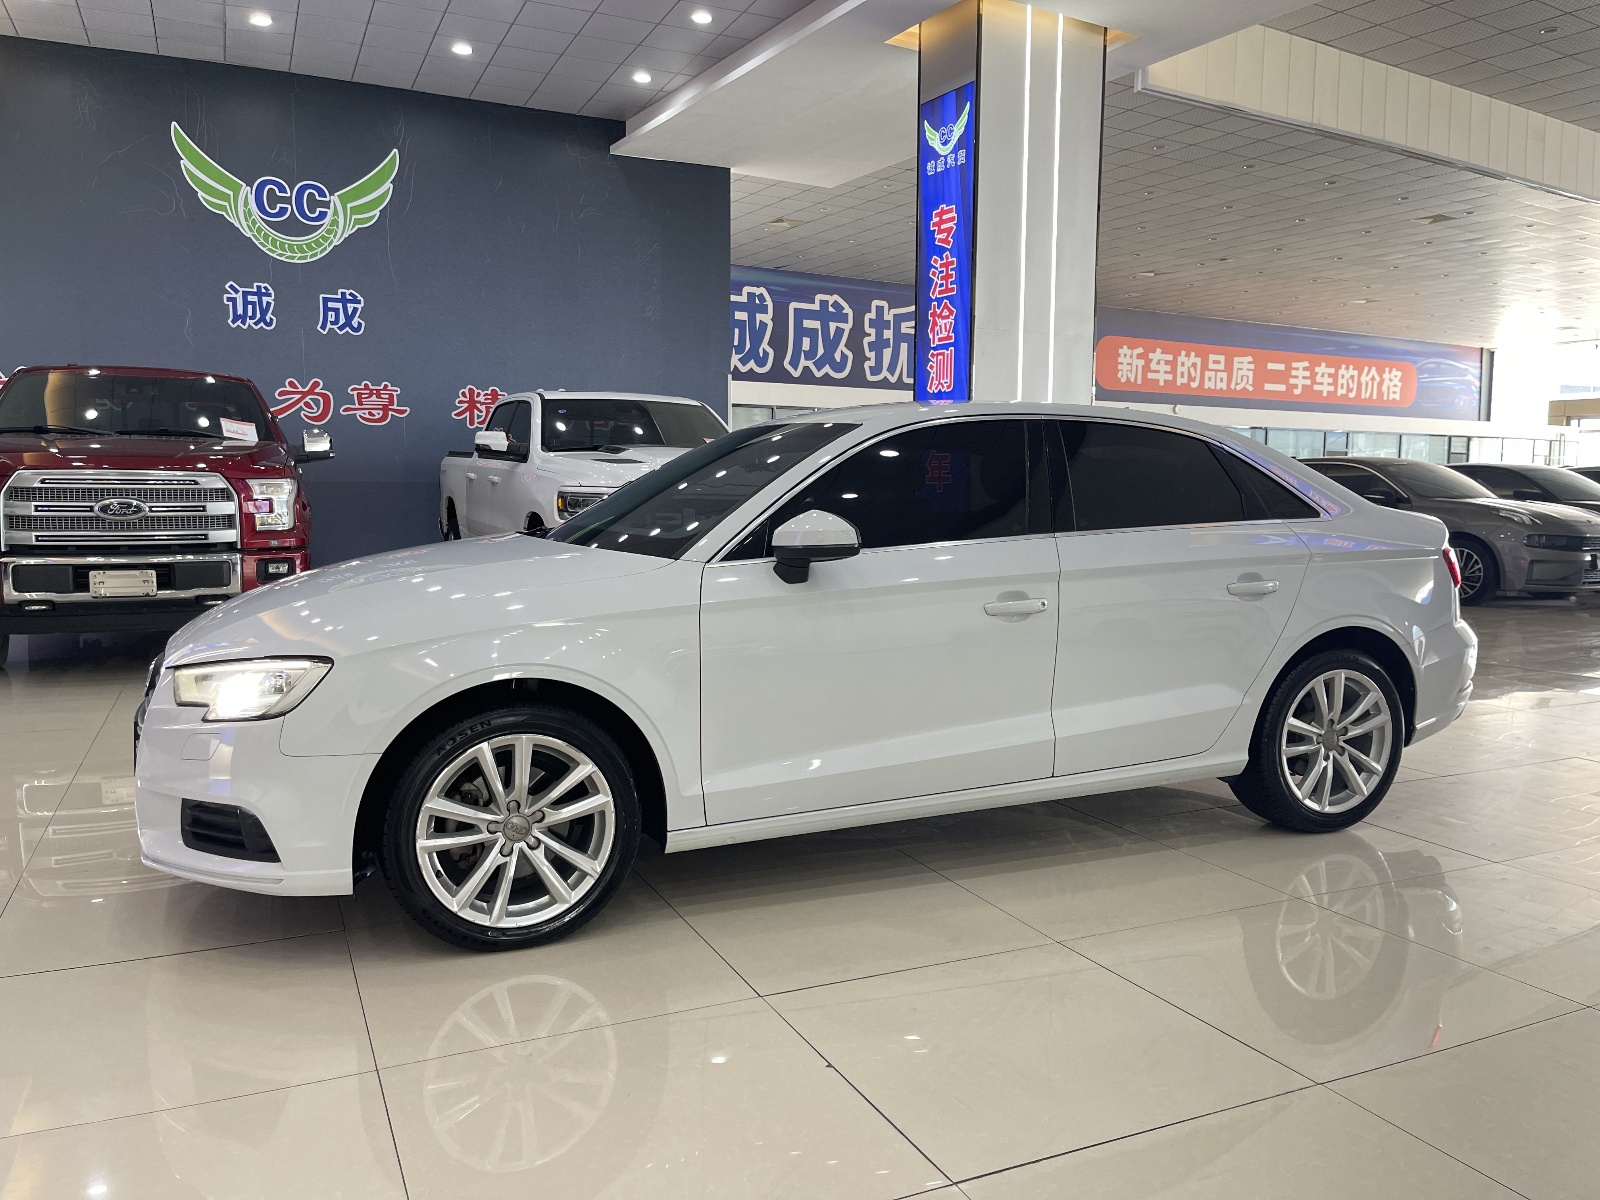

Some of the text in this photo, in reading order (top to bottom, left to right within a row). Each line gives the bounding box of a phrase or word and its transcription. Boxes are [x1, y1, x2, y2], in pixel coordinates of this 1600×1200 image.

[938, 123, 956, 143] CC
[252, 176, 331, 226] CC
[223, 280, 366, 336] 诚成
[927, 204, 958, 393] 专注检测
[1117, 345, 1403, 401] 新车的品质 二手车的价格
[271, 377, 410, 426] 为尊
[925, 450, 952, 493] 年
[107, 502, 137, 515] Ford
